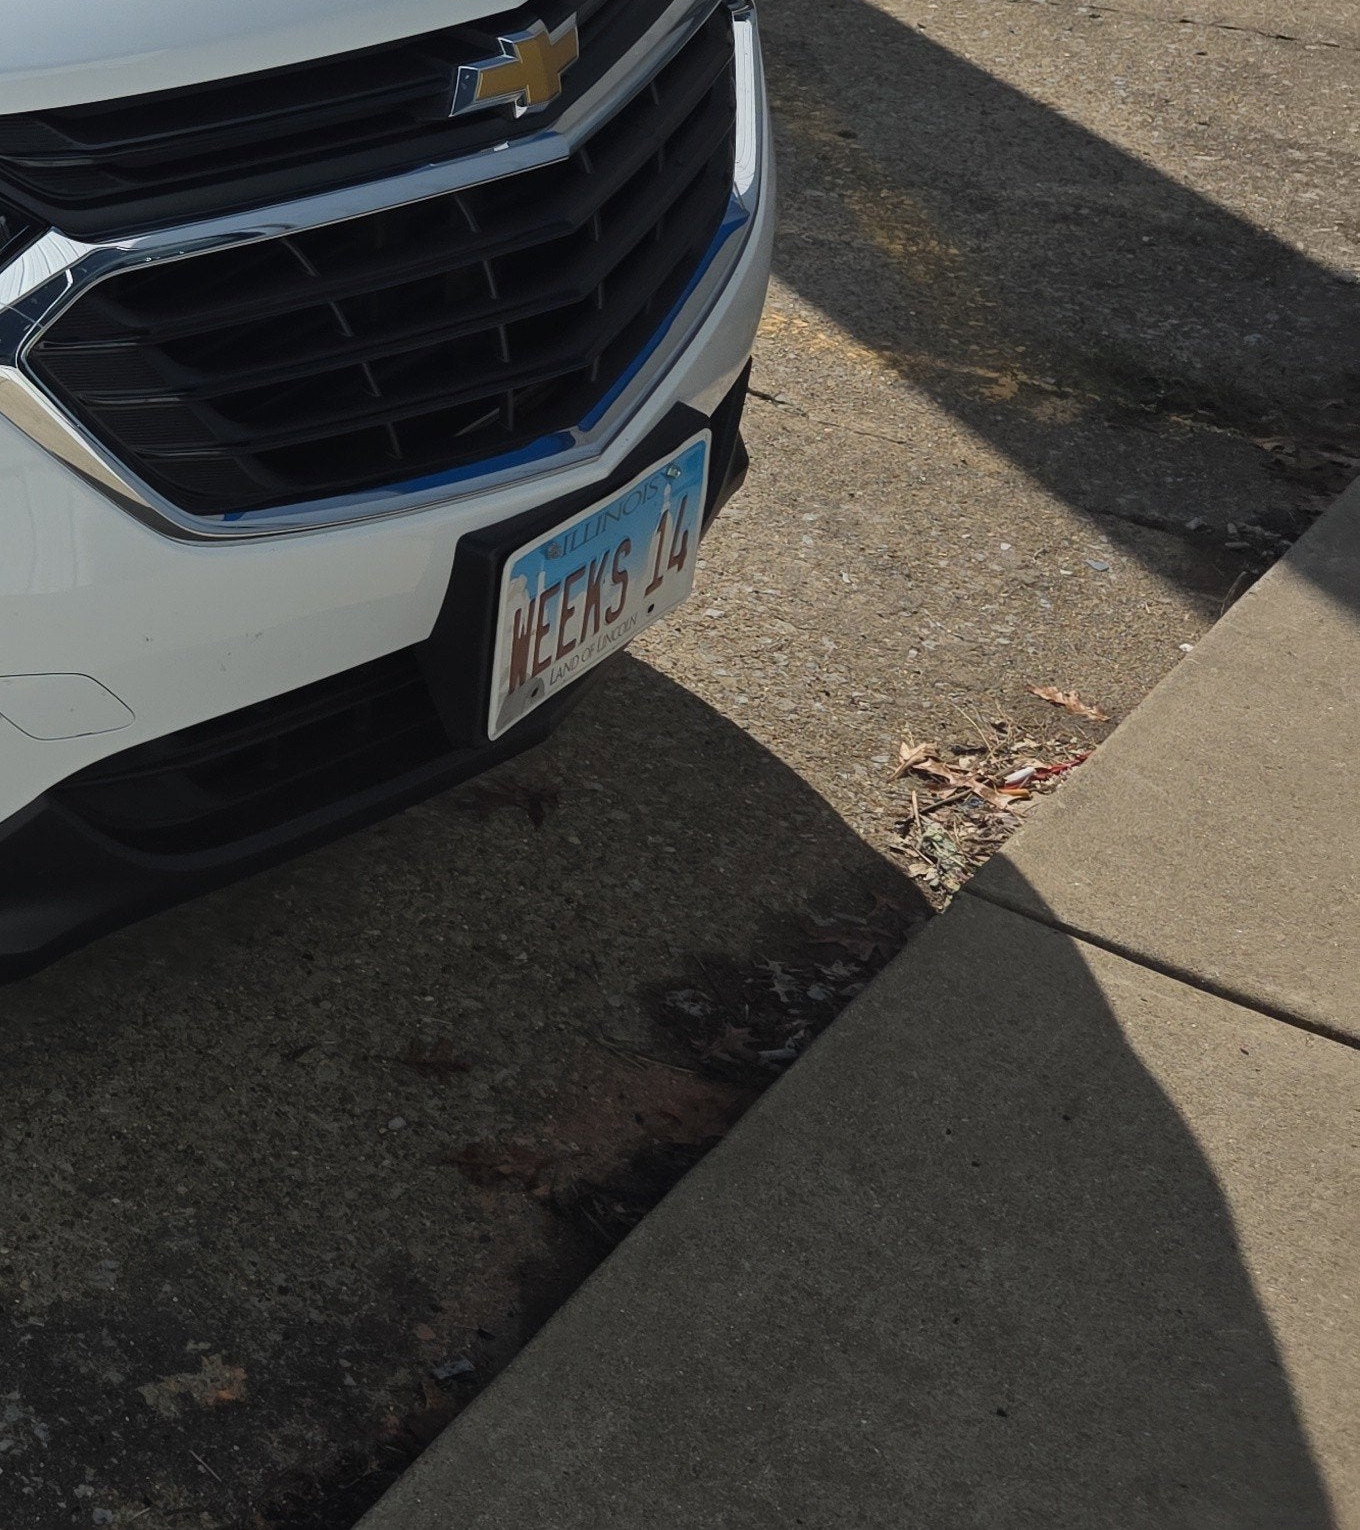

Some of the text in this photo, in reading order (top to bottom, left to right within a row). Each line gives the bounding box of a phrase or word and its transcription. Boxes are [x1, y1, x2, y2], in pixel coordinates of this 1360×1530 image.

[562, 479, 660, 558] ILLINOIS
[508, 494, 689, 696] WEEKS 14
[549, 613, 640, 687] LAND OF LINCOLN
